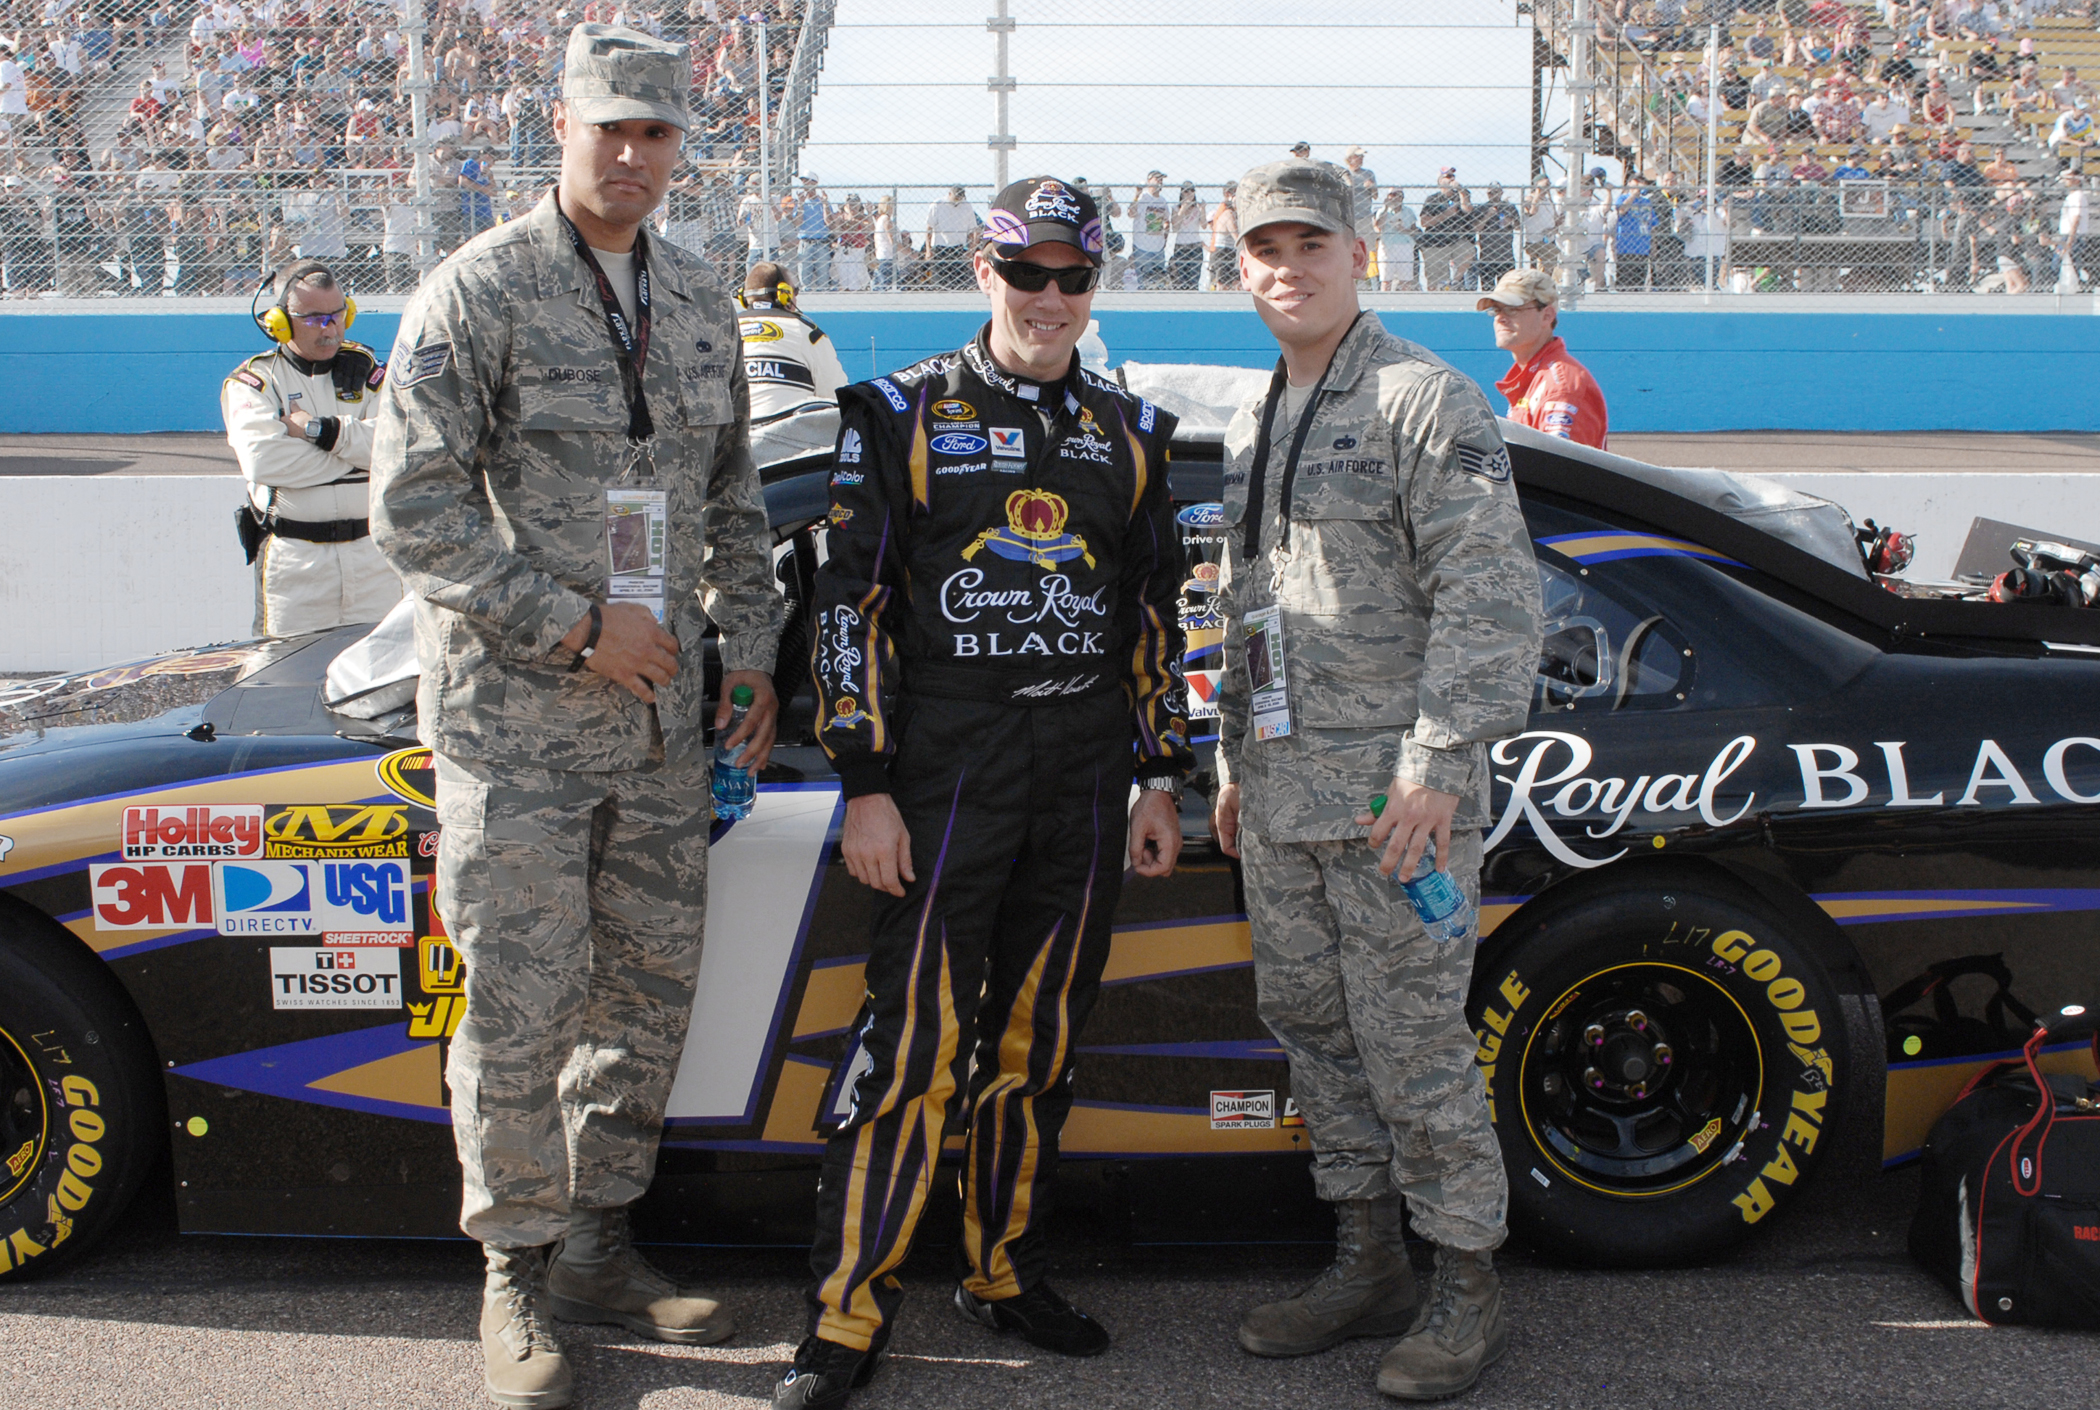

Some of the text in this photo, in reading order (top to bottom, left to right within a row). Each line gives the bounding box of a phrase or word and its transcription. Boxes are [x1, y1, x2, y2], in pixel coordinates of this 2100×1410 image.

[1029, 211, 1077, 223] BLACK
[548, 368, 600, 381] DUBOSE
[894, 358, 961, 383] BLACK
[941, 435, 976, 451] Ford
[1060, 449, 1109, 464] BLACK
[1307, 461, 1384, 475] U.S. AIR FORCE
[1183, 535, 1213, 545] Drive
[940, 567, 1107, 628] Crown Royal
[832, 604, 862, 694] Crown Royal
[953, 632, 1099, 656] BLACK
[1483, 730, 1756, 868] Royal
[127, 807, 260, 856] Holley
[127, 845, 236, 857] HP CARBS
[265, 841, 409, 858] MECHANIX WEAR
[97, 864, 214, 926] 3M
[325, 863, 406, 924] USG
[226, 918, 313, 931] DIRECTV
[325, 933, 407, 945] SHEETROCK
[275, 974, 398, 994] TISSOT
[1712, 930, 1828, 1224] GOODYEAR
[1215, 1100, 1269, 1113] CHAMPION
[1697, 1123, 1718, 1146] AERO
[12, 1146, 32, 1170] AERO
